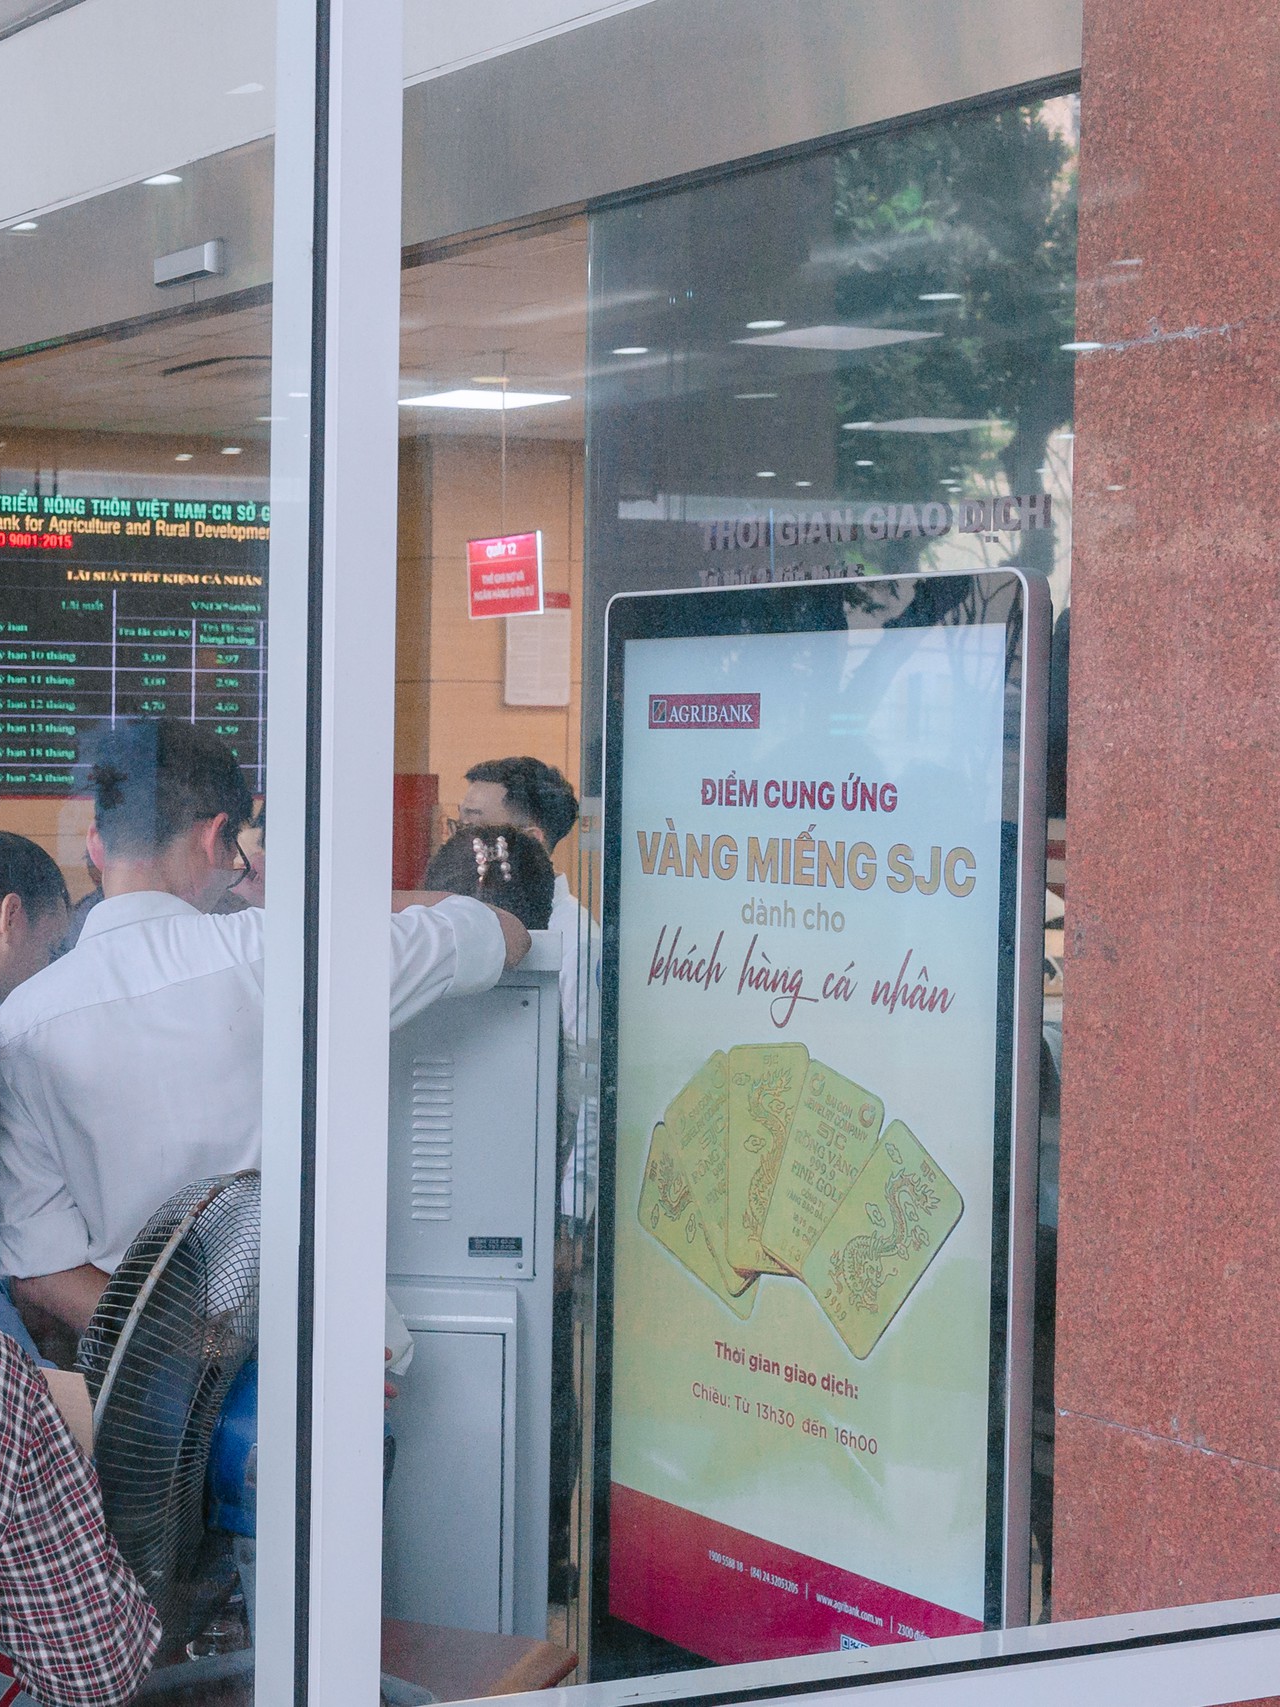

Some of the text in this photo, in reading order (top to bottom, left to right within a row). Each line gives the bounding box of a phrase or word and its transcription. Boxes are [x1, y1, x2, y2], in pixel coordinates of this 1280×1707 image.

[25, 515, 44, 532] for
[49, 516, 120, 535] Agriculture
[125, 520, 150, 536] and
[156, 520, 190, 537] Rural
[44, 494, 85, 515] NÔNG
[91, 496, 131, 517] THÔN
[136, 498, 169, 521] VIỆT
[863, 501, 952, 541] GIAO
[959, 494, 1051, 543] DỊCH
[9, 533, 73, 549] 9001:2015
[668, 704, 754, 724] AGRIBANK
[701, 770, 898, 812] ĐIỂM CUNG ỨNG
[637, 818, 977, 898] VÀNG MIẾNG SJC
[741, 897, 846, 933] dành cho
[647, 925, 956, 1029] khách hàng cá nhân
[714, 1340, 859, 1400] Thời gian giao dịch:
[691, 1382, 879, 1456] Chiều: Từ 13h30 đến 16h00
[708, 1549, 721, 1563] 1900
[750, 1566, 762, 1581] (84)
[816, 1593, 914, 1638] www.agribank.com.vn 2300
